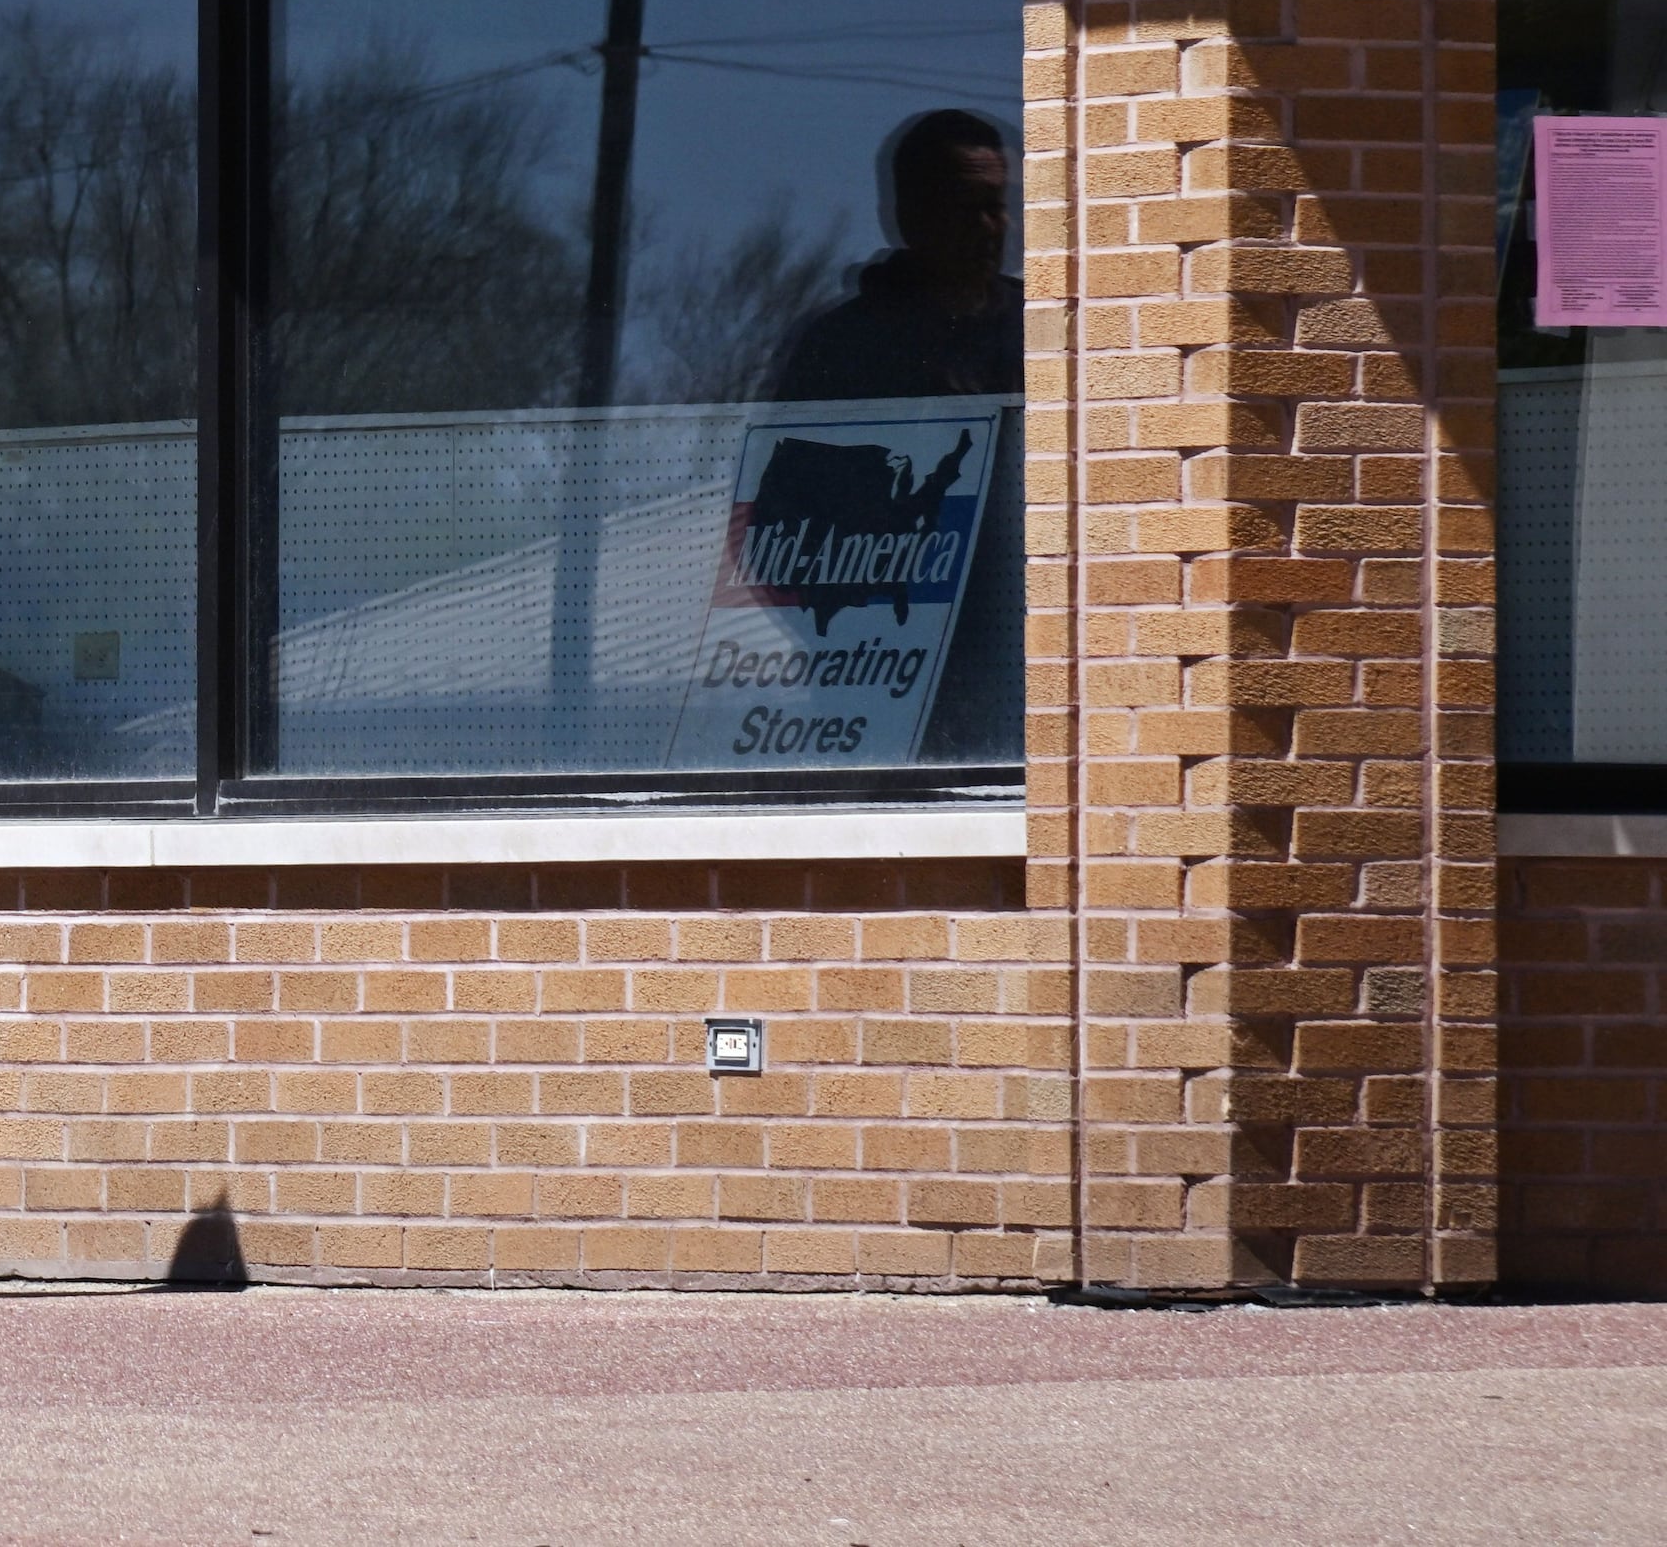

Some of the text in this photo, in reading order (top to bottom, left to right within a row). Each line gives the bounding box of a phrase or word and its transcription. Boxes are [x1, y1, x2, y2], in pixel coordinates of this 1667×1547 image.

[726, 516, 961, 588] Mid-America
[702, 637, 927, 699] Decorating
[733, 705, 867, 755] Stores
